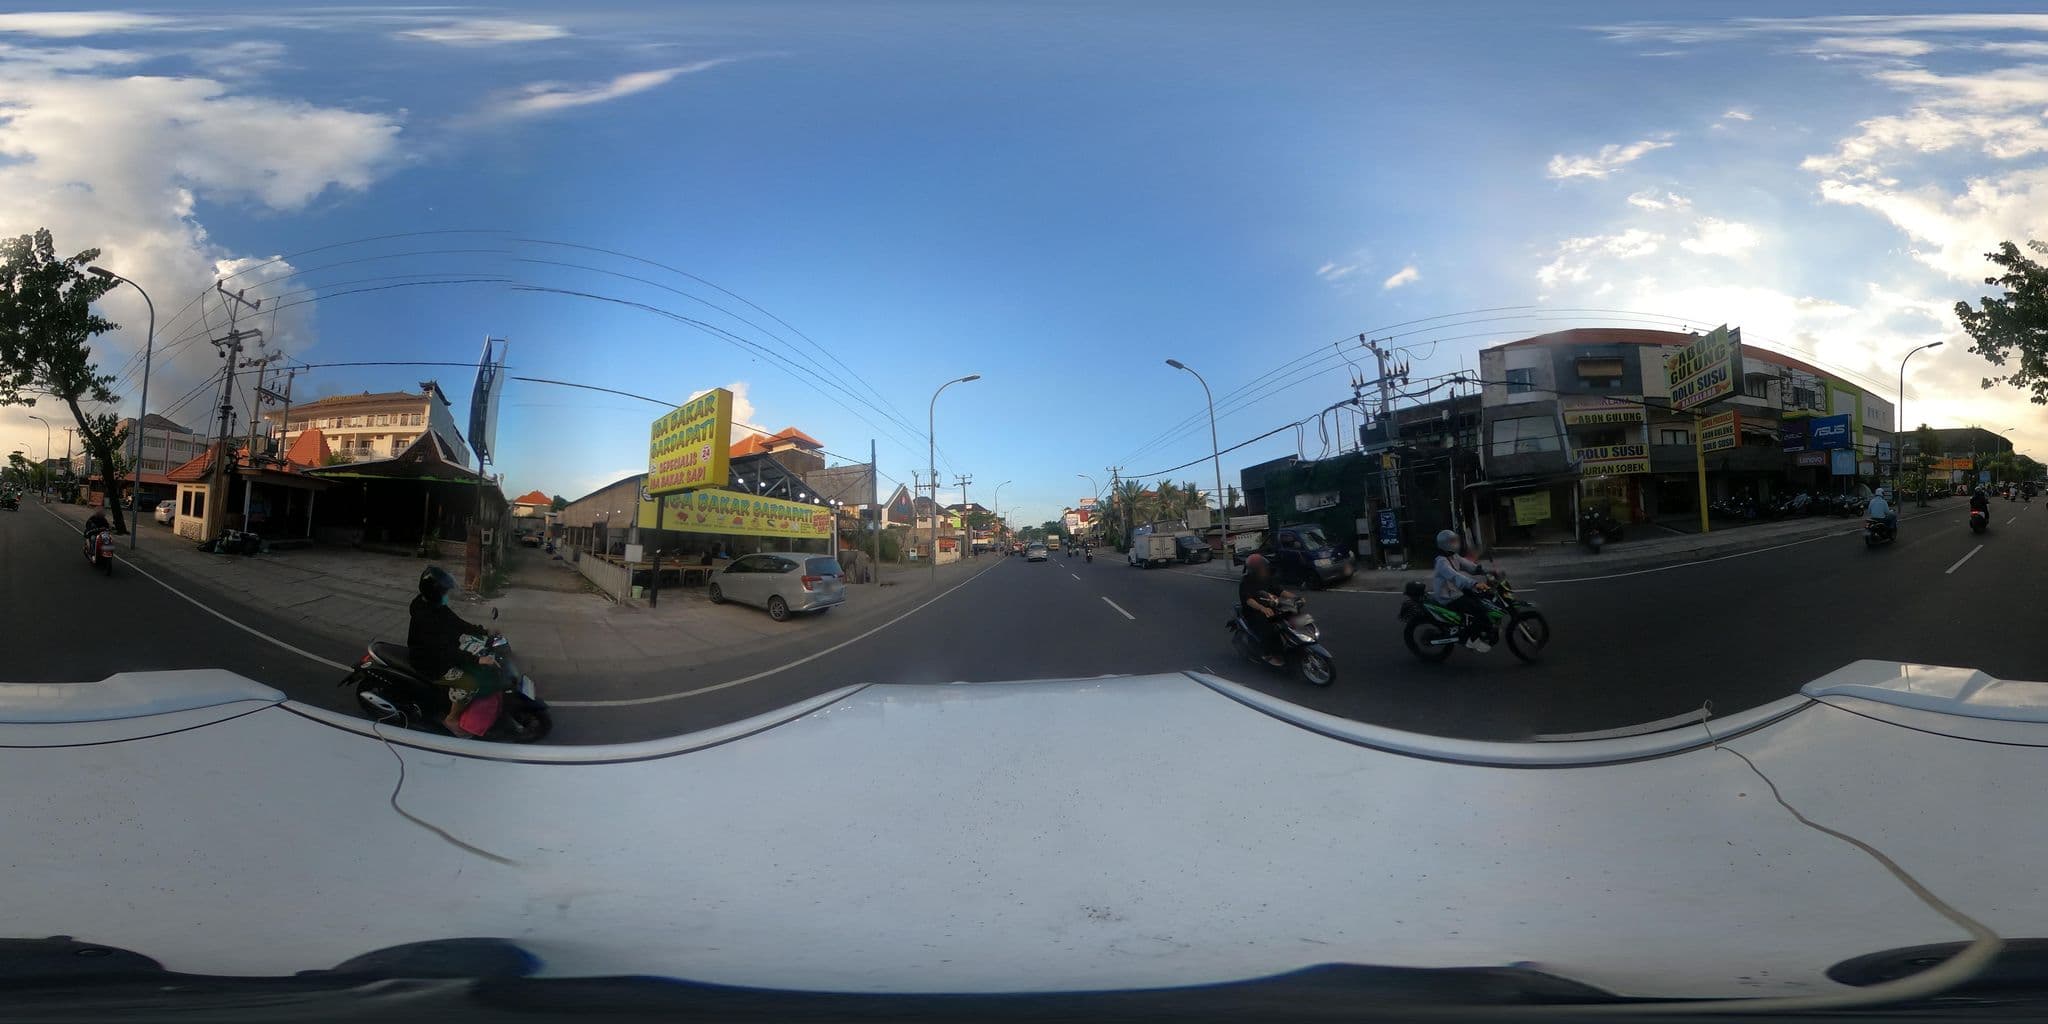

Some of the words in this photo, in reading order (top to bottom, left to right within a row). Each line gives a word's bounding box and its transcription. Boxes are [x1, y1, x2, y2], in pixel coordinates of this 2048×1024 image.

[1679, 333, 1717, 366] ABON
[1671, 344, 1726, 384] GULUNG
[1673, 381, 1694, 402] BOLU
[1697, 366, 1727, 391] SUSU
[1579, 414, 1605, 423] ABON
[1606, 412, 1642, 422] GULUNG
[1814, 424, 1846, 437] ASUS
[1612, 445, 1644, 457] SUSU
[1615, 463, 1645, 474] SOBEK
